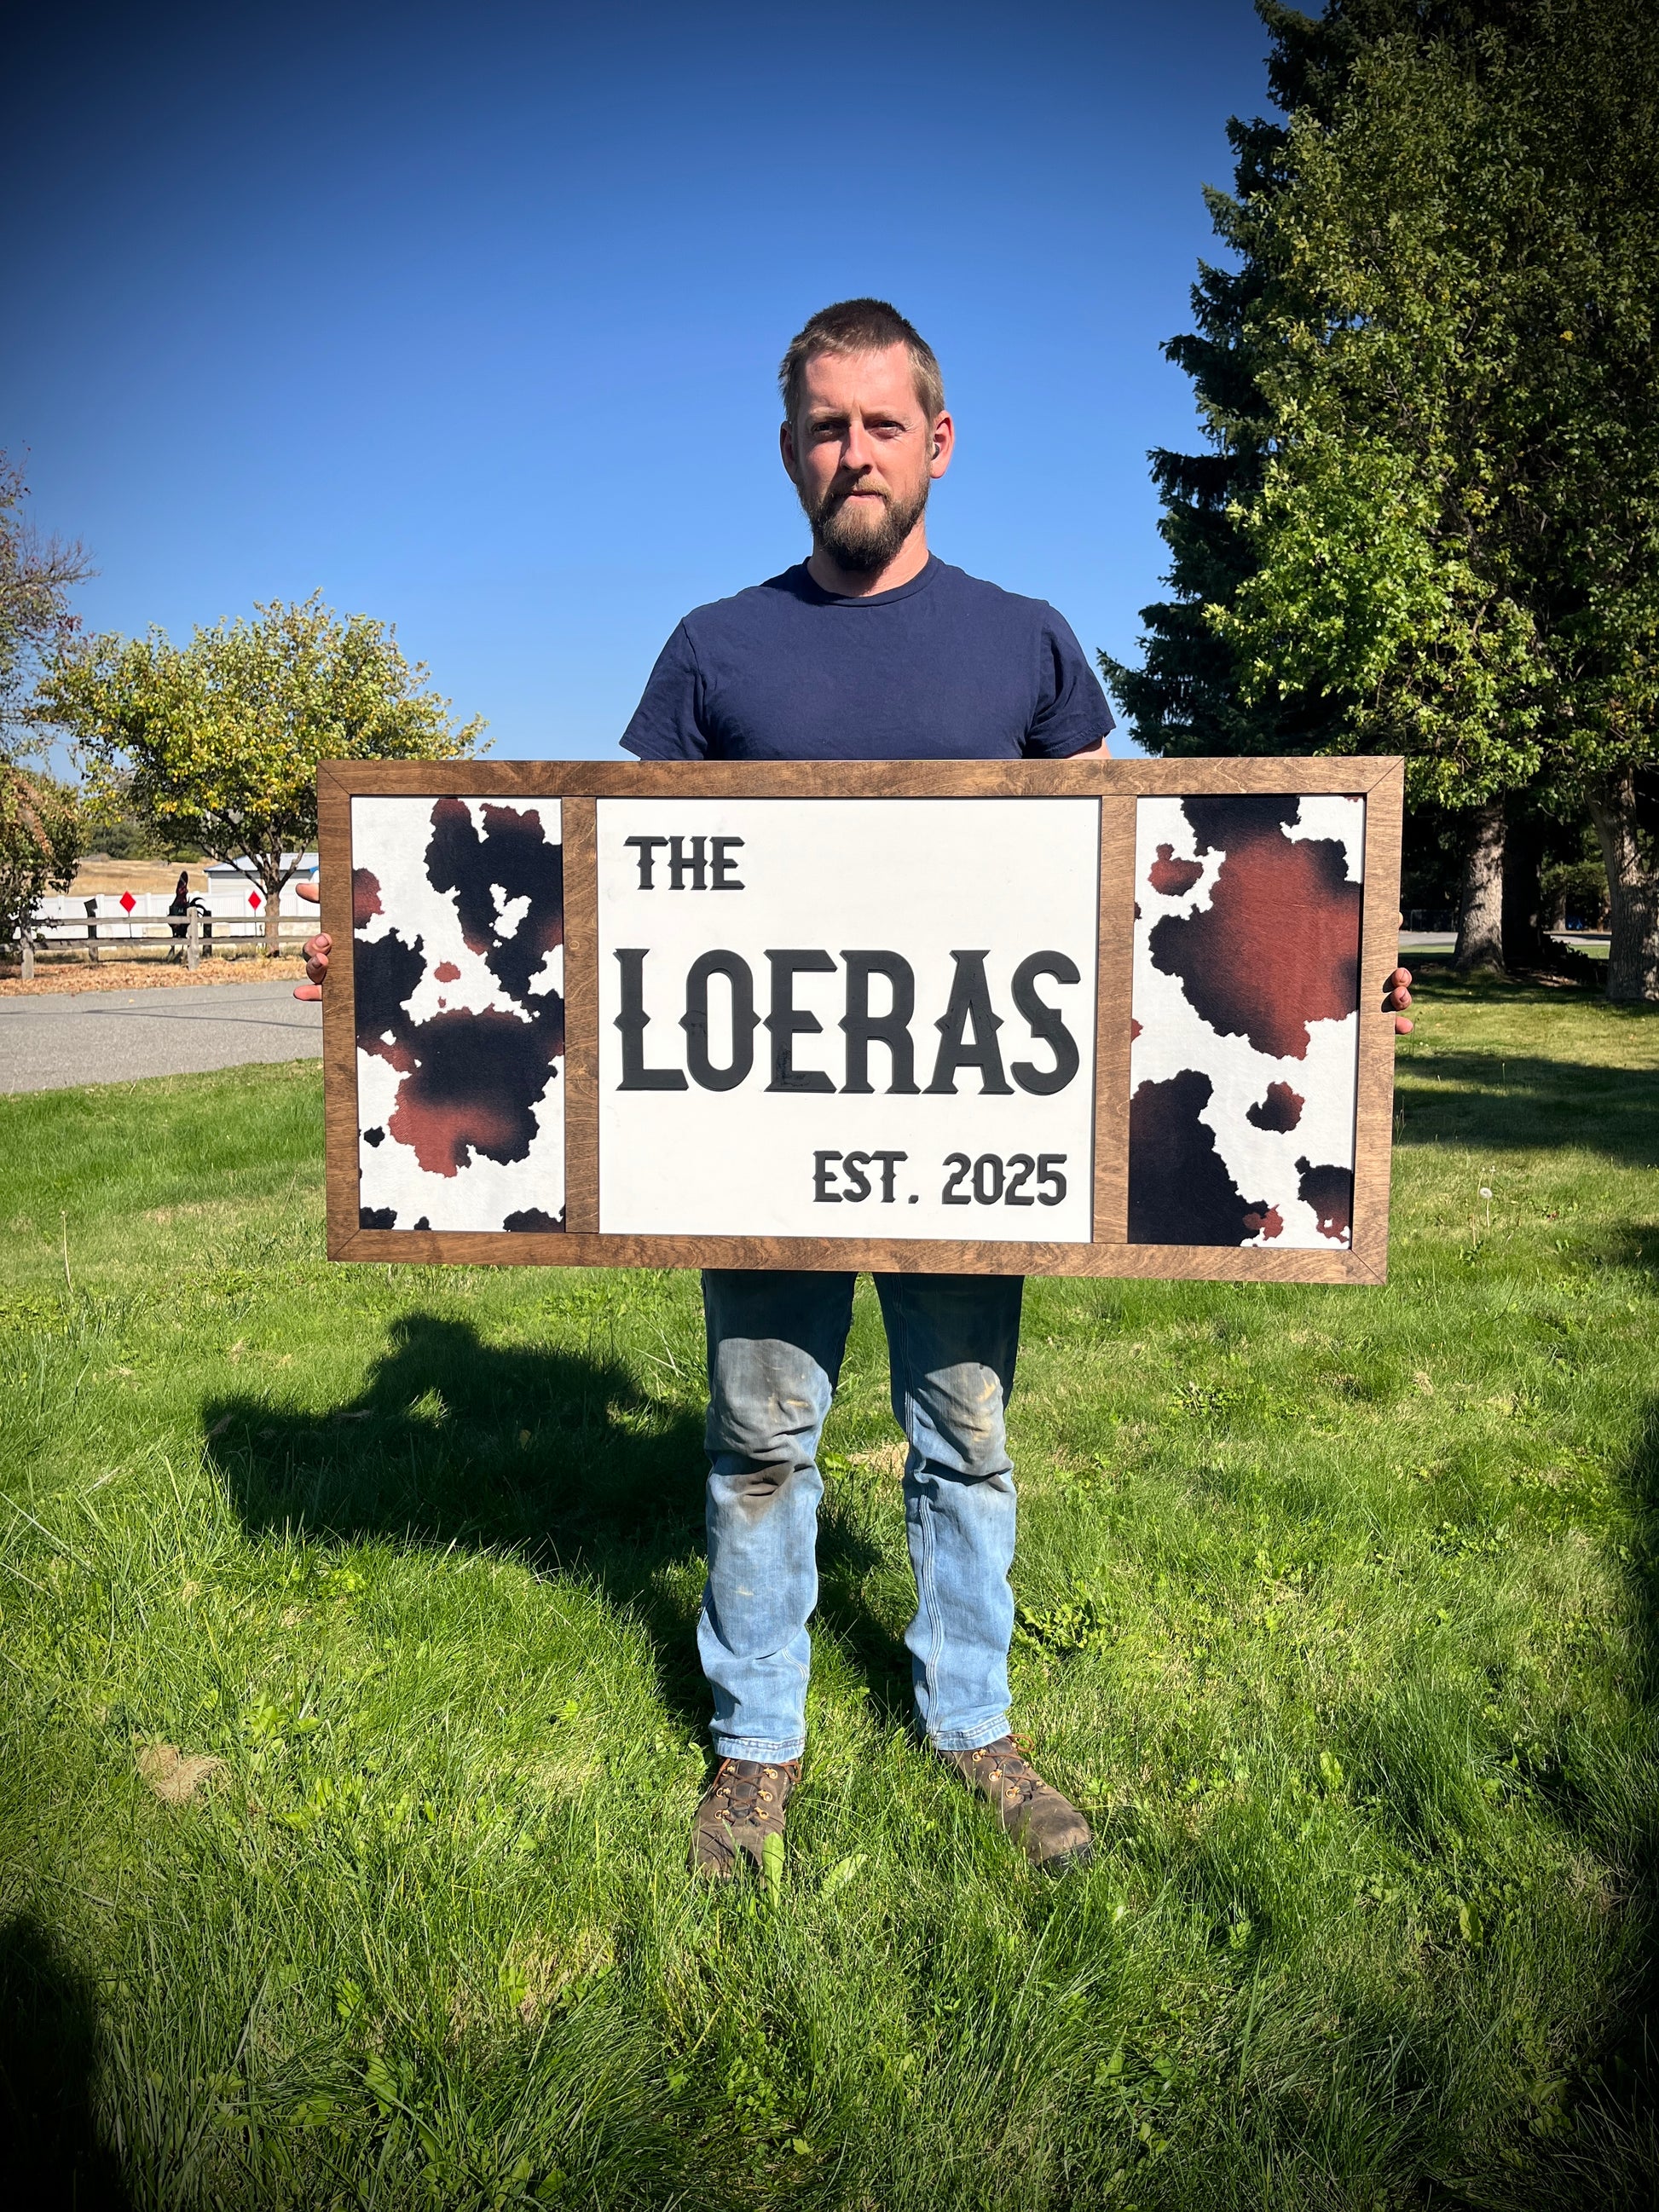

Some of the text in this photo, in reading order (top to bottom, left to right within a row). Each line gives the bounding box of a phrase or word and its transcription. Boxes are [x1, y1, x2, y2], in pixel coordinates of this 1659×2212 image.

[623, 835, 745, 891] THE
[613, 948, 1081, 1096] LOERAS
[812, 1150, 1067, 1206] EST. 2025
